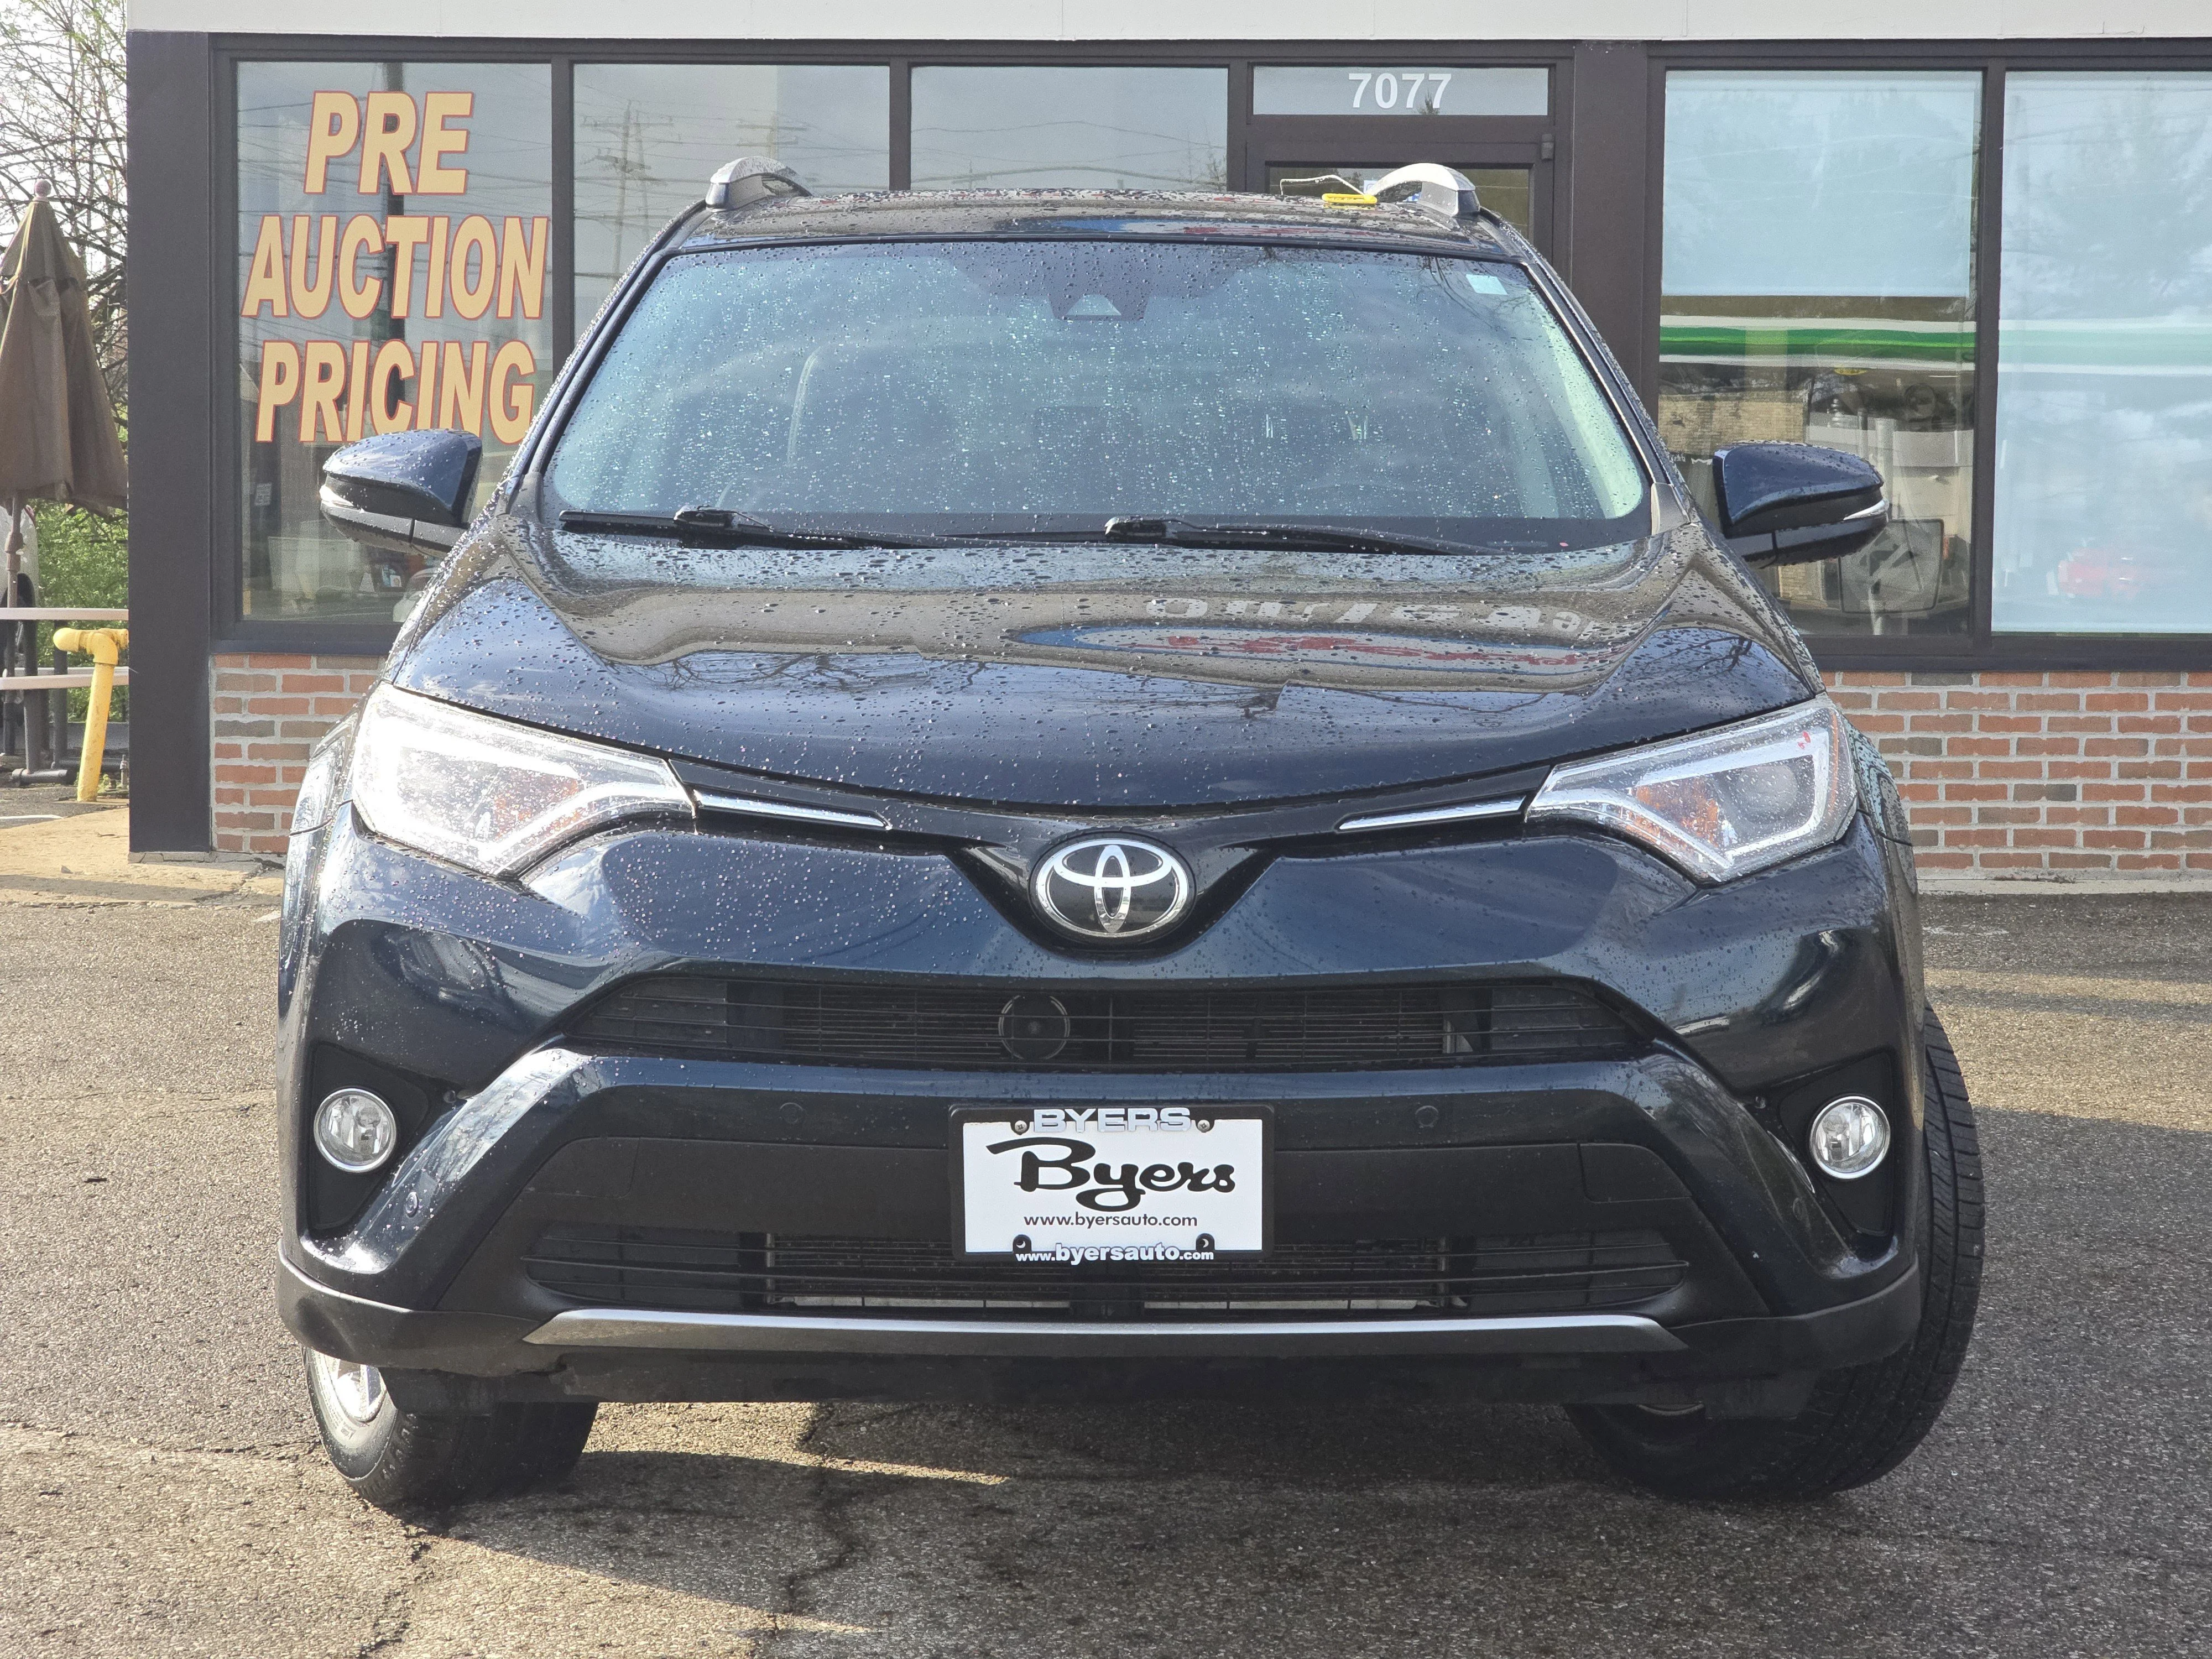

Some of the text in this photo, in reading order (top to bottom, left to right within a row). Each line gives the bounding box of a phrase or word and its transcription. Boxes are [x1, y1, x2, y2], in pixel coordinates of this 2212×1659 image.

[1348, 73, 1452, 109] 7077
[302, 90, 473, 195] PRE
[241, 215, 549, 320] AUCTION
[255, 339, 536, 444] PRICING
[1033, 1107, 1192, 1133] BYERS
[985, 1136, 1237, 1212] Byers
[1023, 1212, 1198, 1229] www.byersauto.com
[1015, 1242, 1215, 1266] www.byersauto.com
